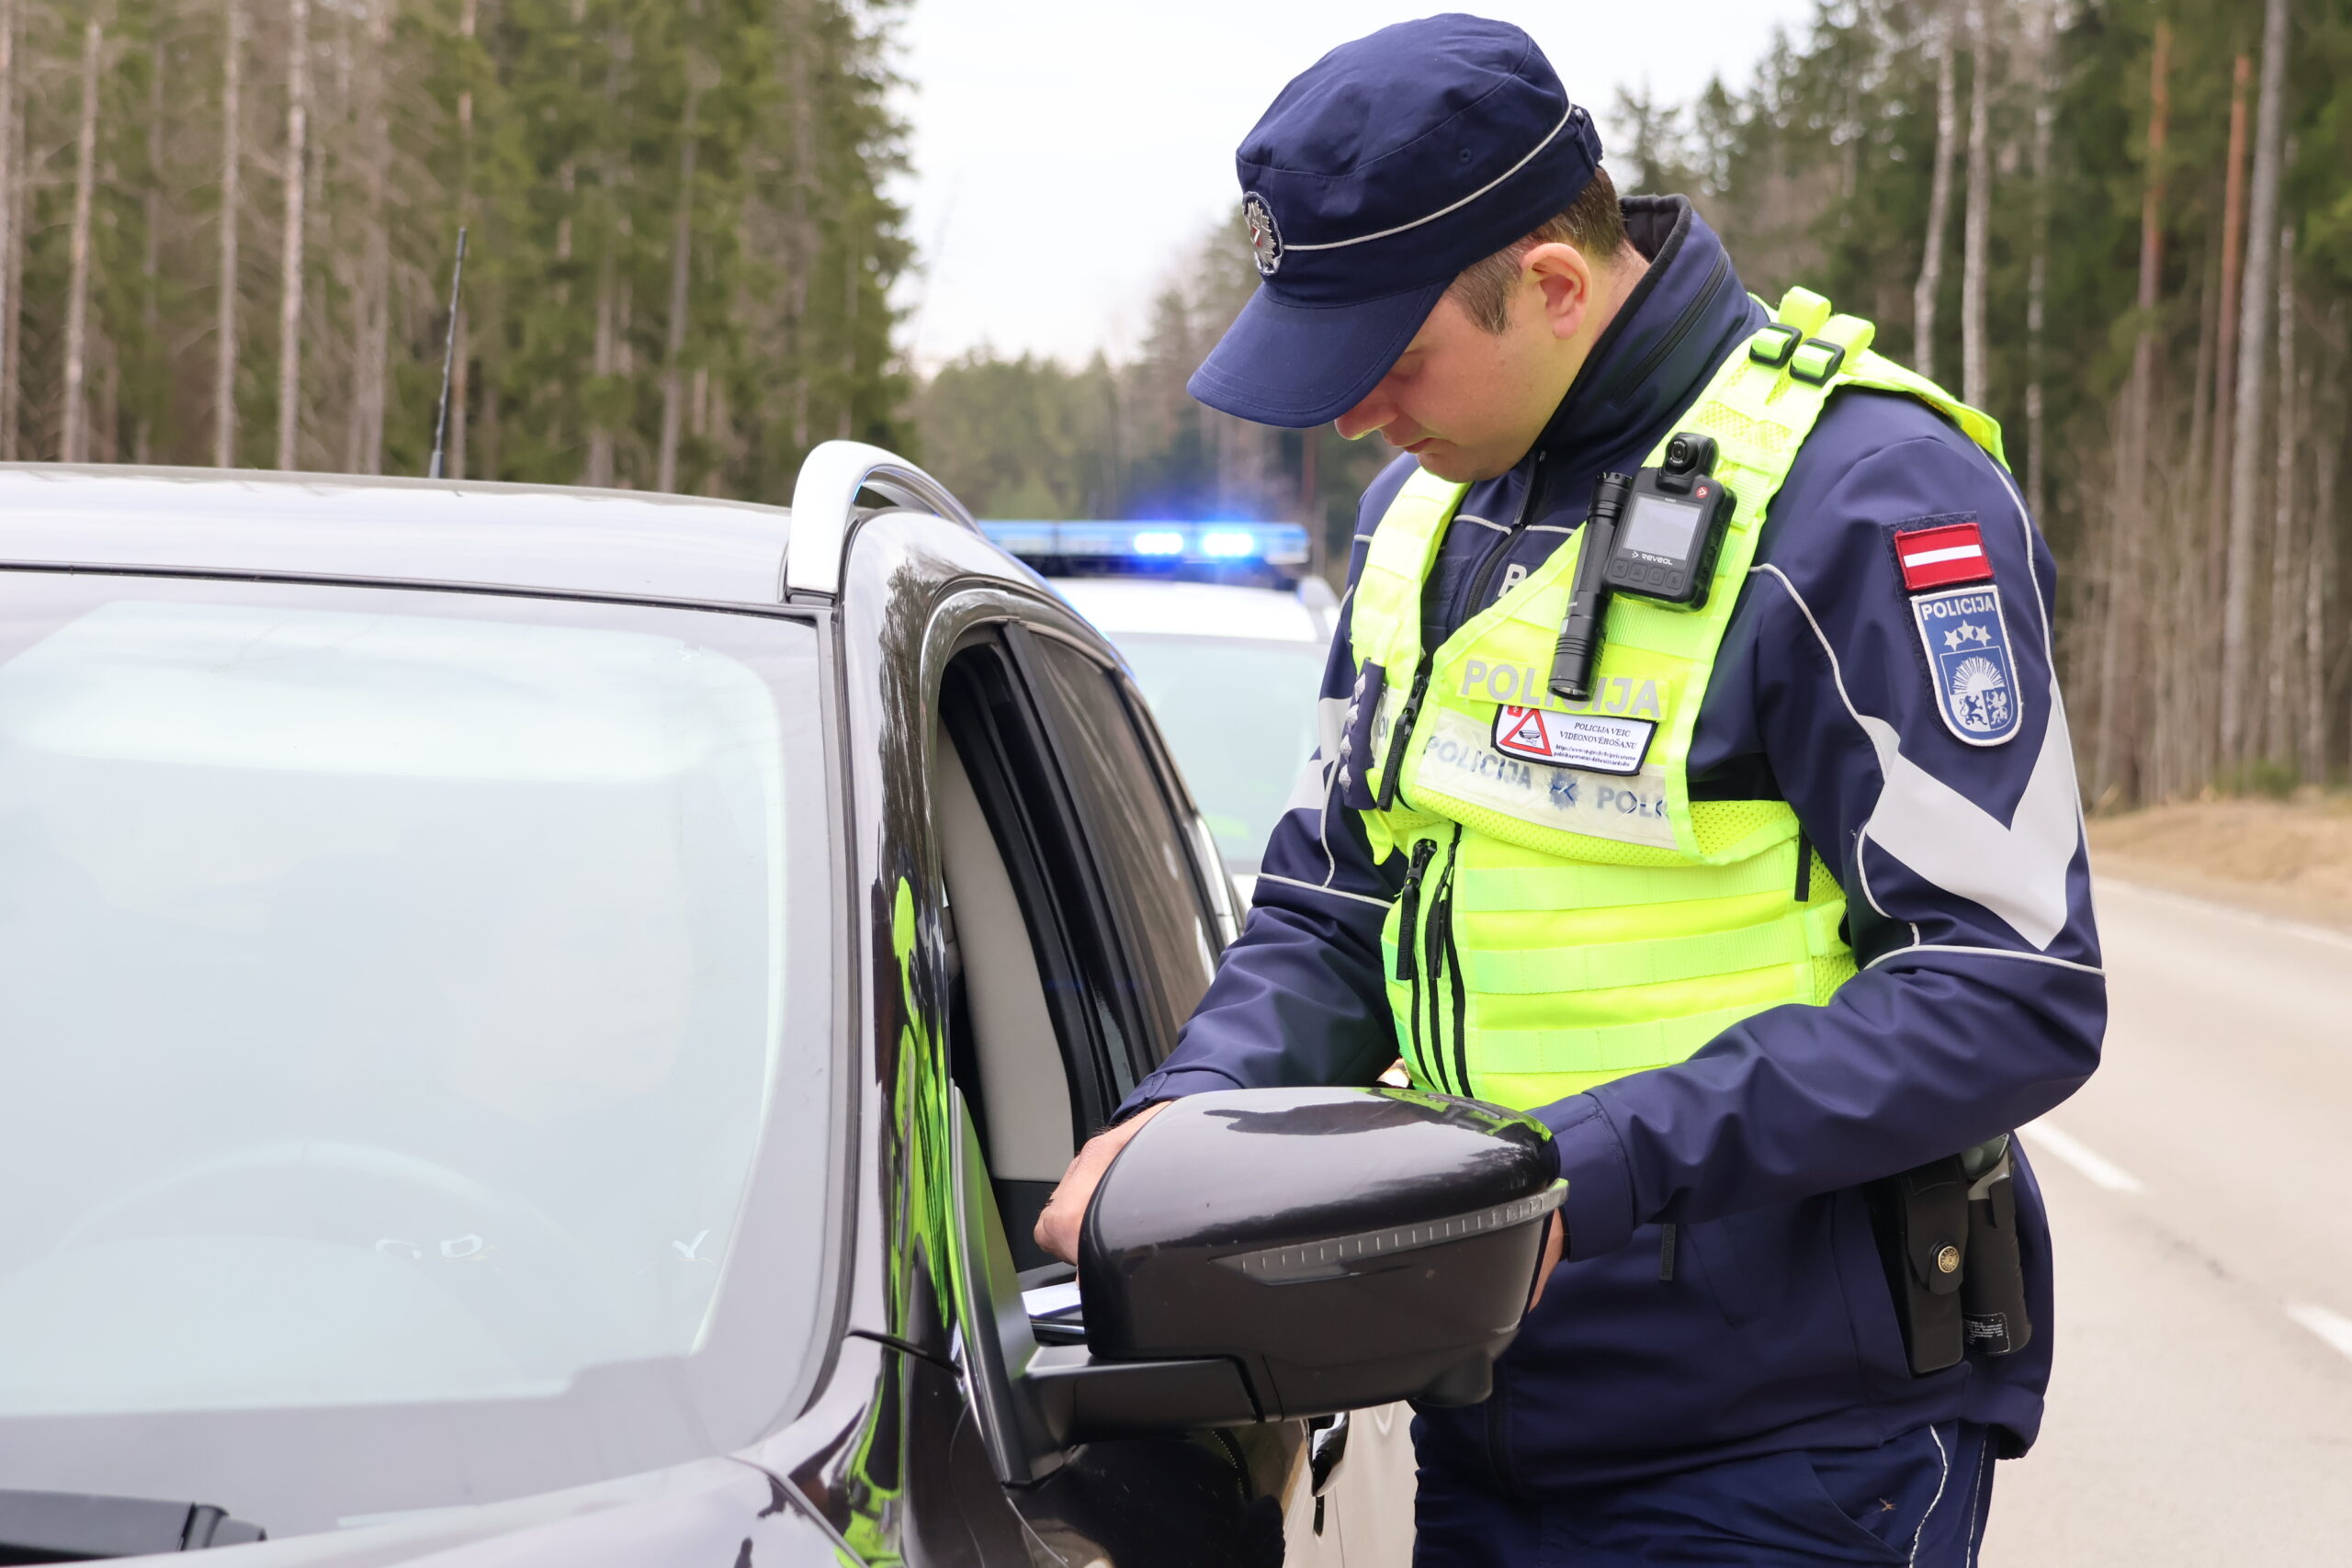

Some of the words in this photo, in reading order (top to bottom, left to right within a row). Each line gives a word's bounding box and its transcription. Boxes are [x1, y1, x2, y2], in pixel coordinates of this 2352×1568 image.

[1921, 595, 1996, 621] POLICIJA
[1461, 660, 1661, 717] POLIJA
[1560, 730, 1637, 750] VIDEONOVĒROŠANU
[1574, 722, 1610, 735] POLICIJA
[1611, 728, 1631, 738] VEIC
[1423, 735, 1532, 789] POLICIJA
